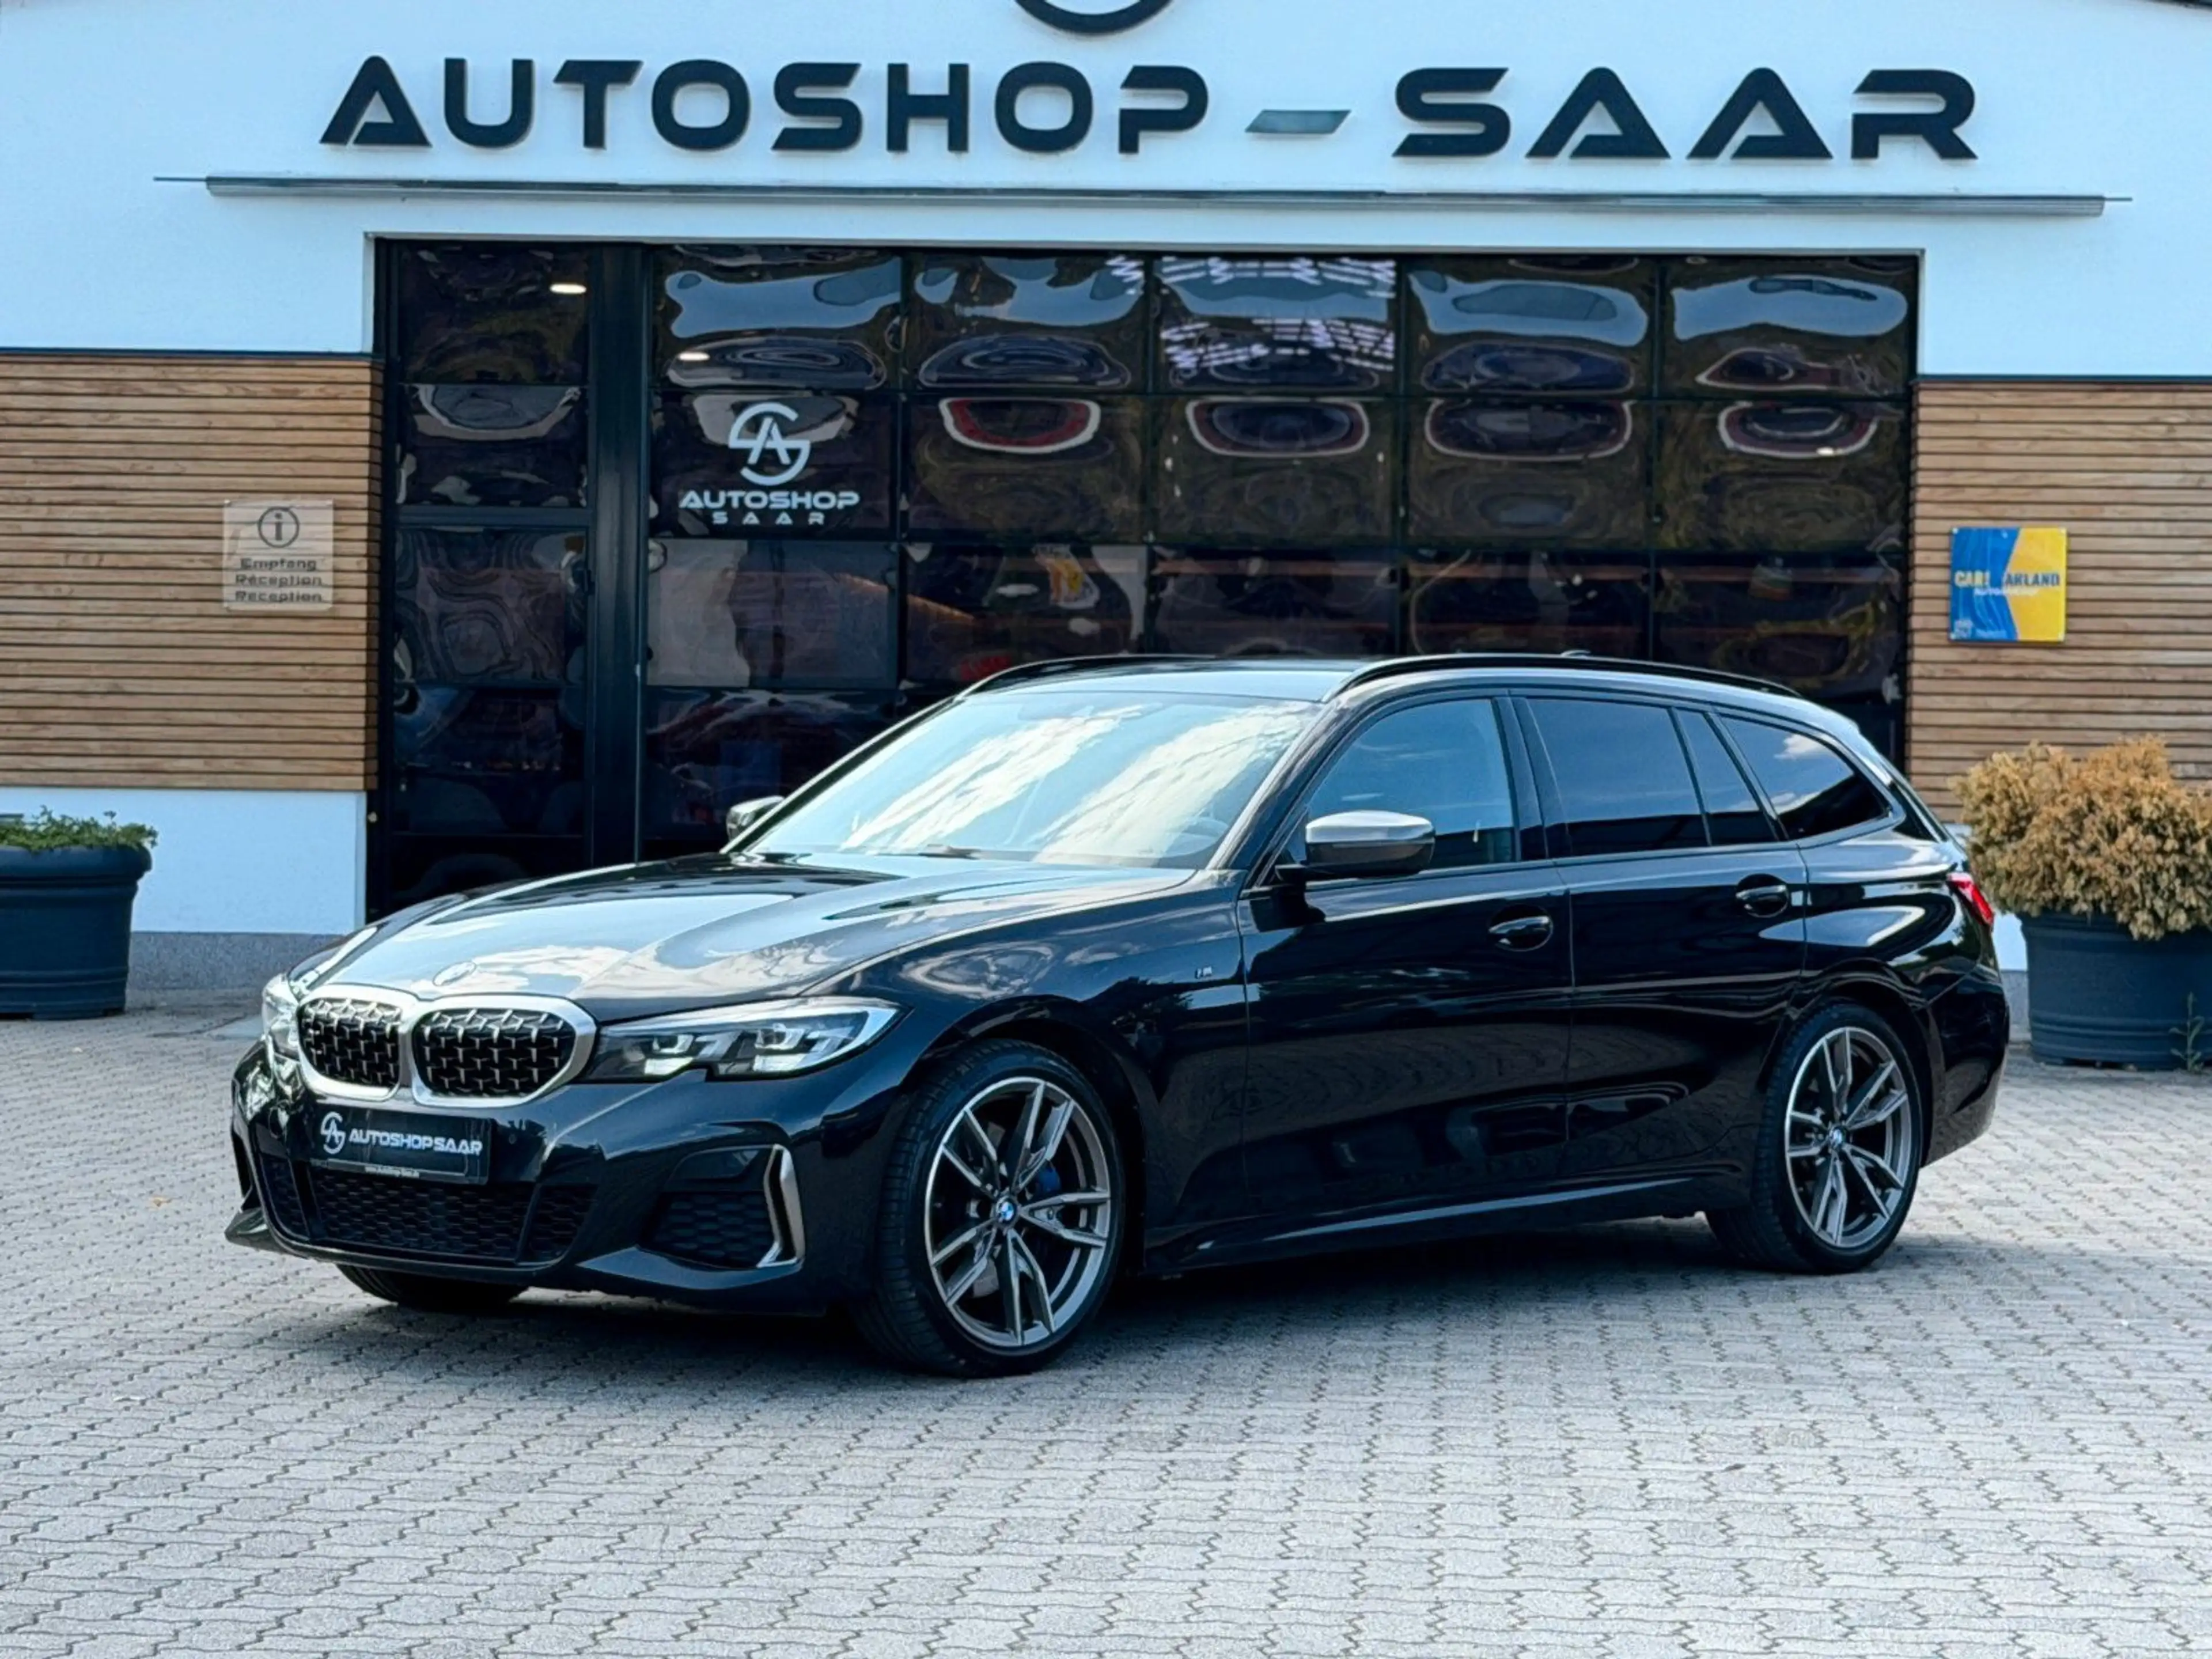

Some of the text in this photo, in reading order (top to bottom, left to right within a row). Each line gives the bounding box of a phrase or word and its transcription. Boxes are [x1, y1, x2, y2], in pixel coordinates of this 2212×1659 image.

[319, 55, 1209, 154] AUTOSHOP
[1392, 67, 1979, 160] SAAR
[678, 490, 860, 509] AUTOSHOP
[712, 511, 825, 525] SAAR
[240, 558, 317, 571] Empfang
